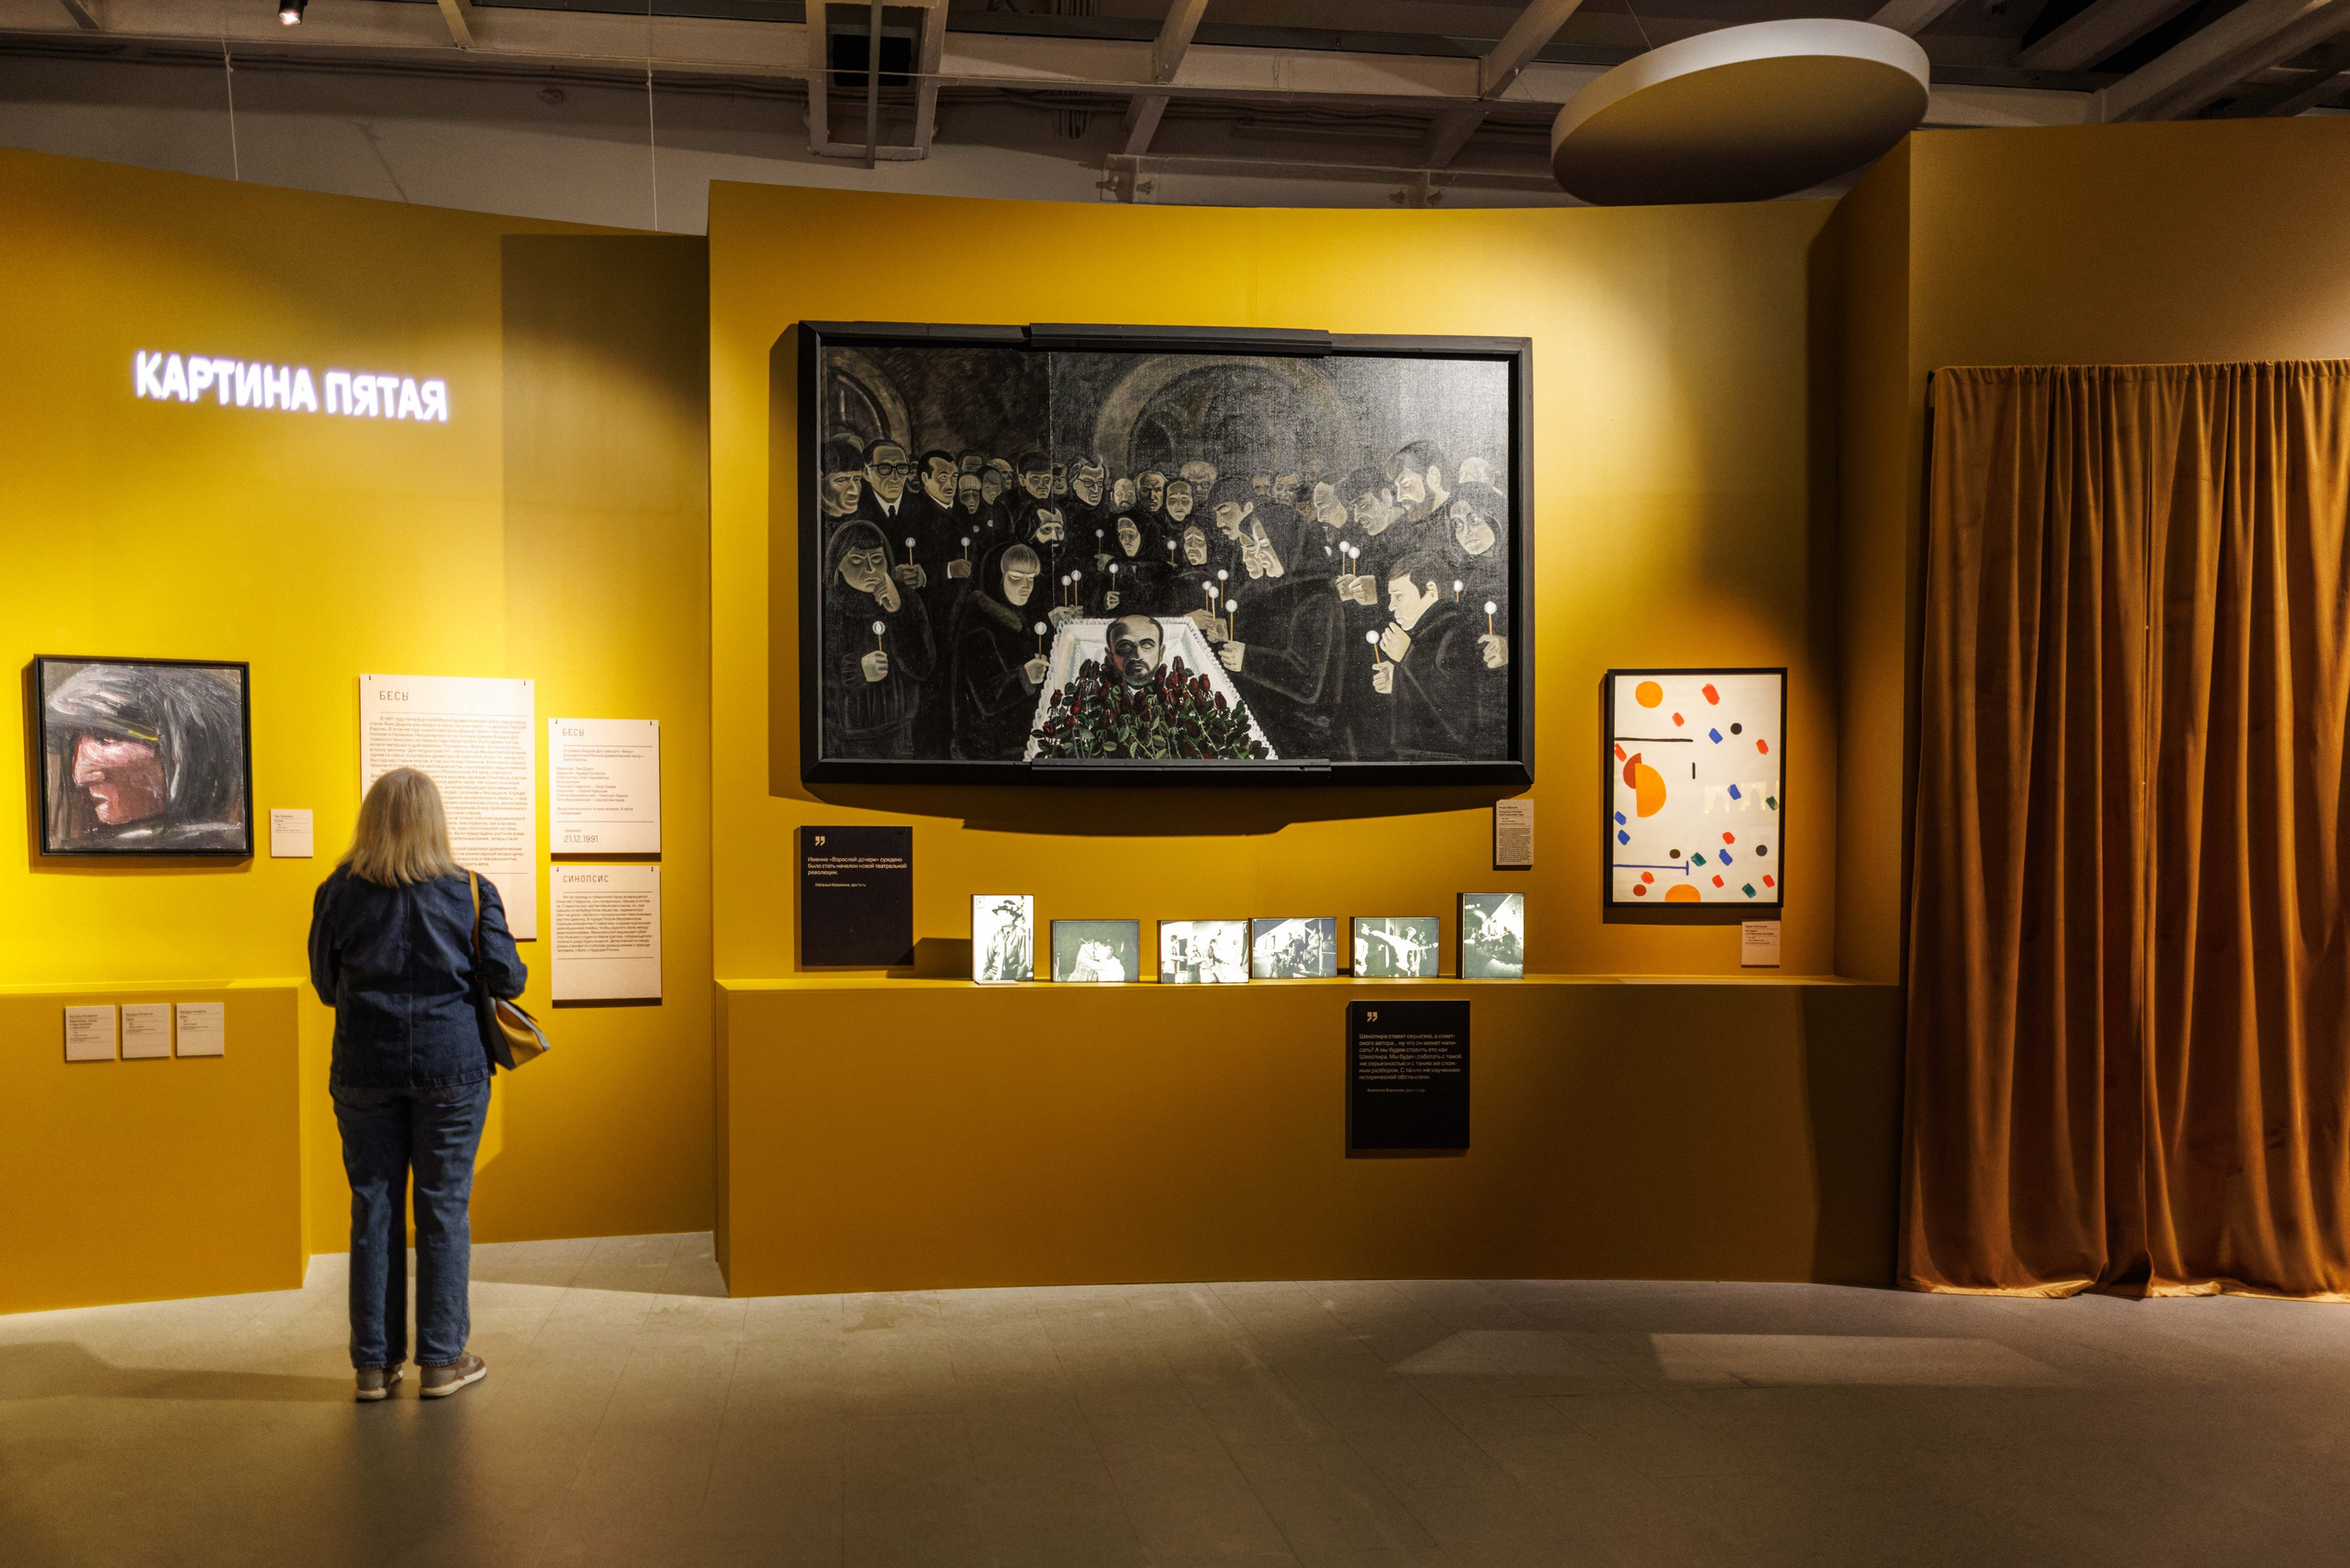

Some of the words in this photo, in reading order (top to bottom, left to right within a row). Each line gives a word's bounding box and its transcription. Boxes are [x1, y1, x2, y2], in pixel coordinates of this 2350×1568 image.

[136, 350, 318, 412] КАРТИНА
[326, 371, 448, 421] ПЯТАЯ
[564, 834, 599, 843] 21.12.1991
[563, 875, 610, 883] СИНОПСИС
